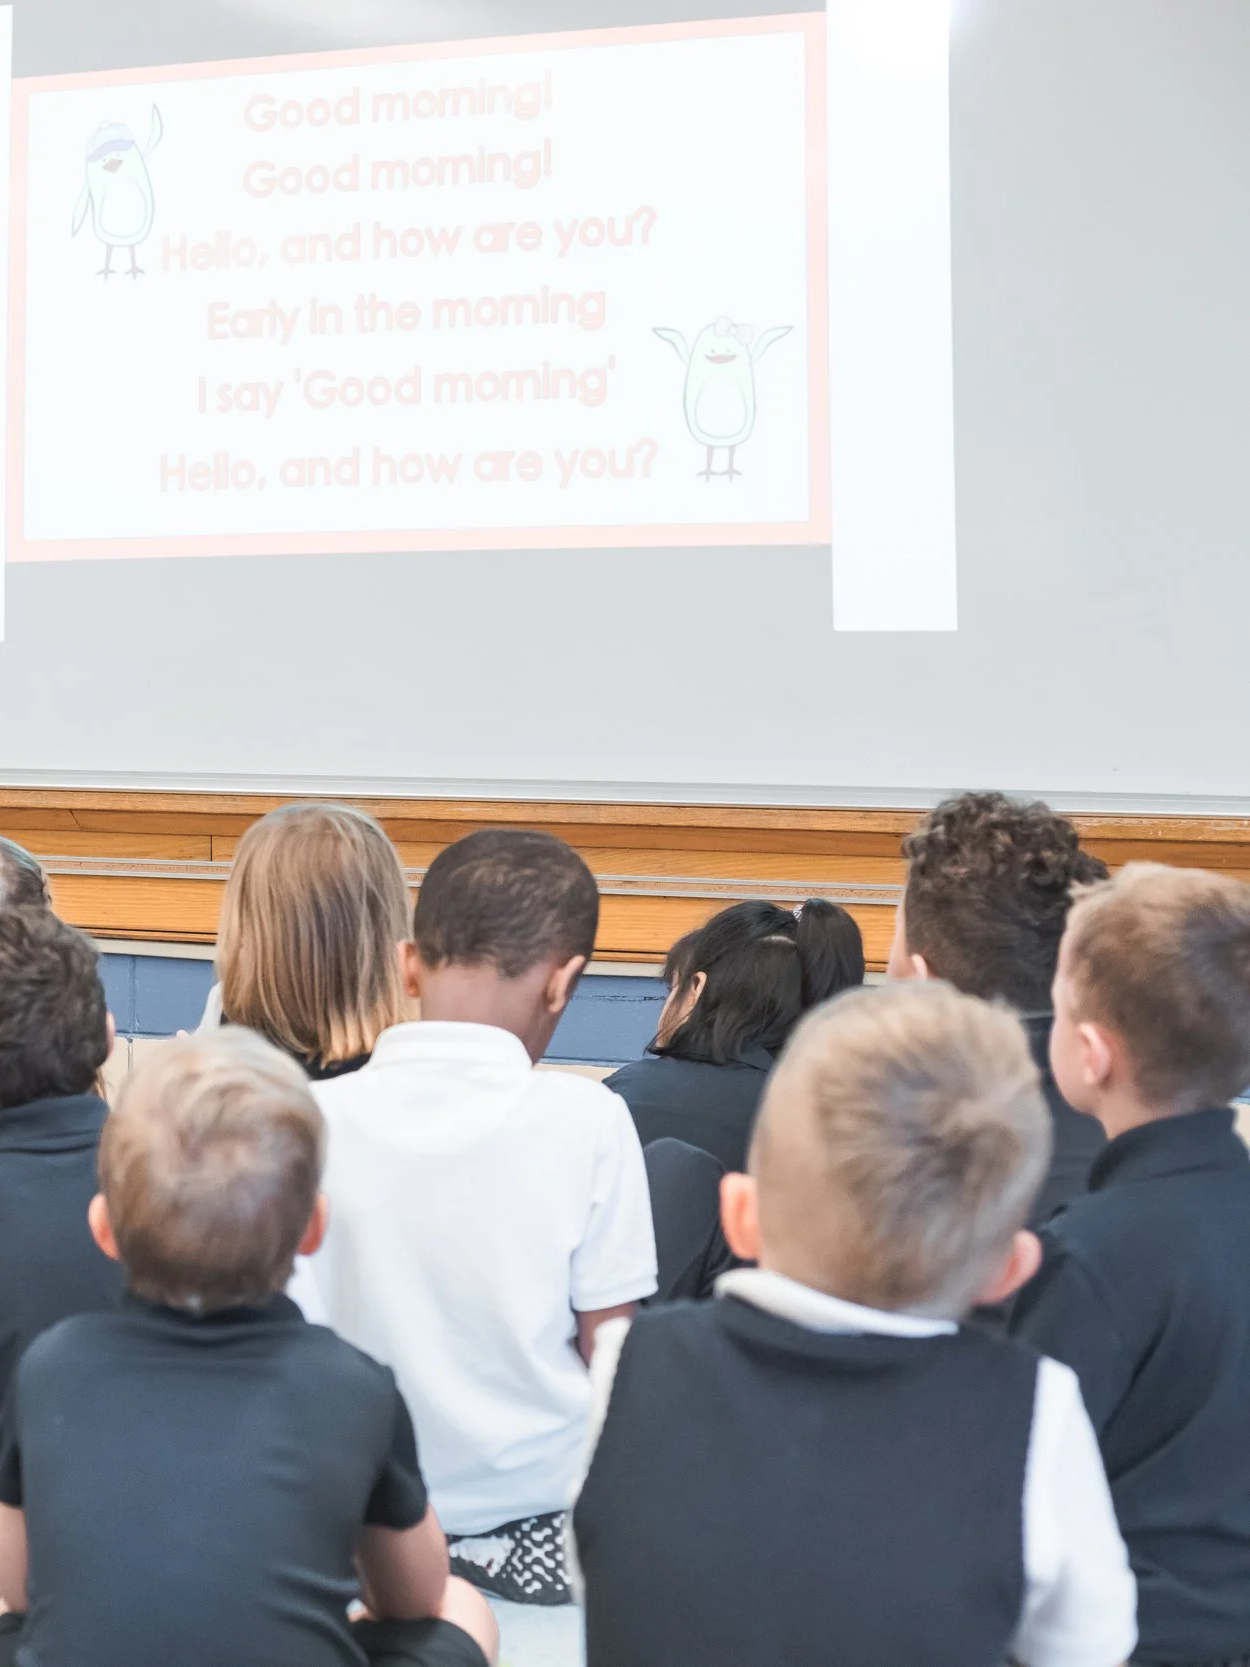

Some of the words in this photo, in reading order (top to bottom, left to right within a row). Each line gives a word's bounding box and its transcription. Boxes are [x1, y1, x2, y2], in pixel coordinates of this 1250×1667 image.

[243, 87, 360, 133] Good
[372, 69, 553, 123] morning!
[242, 153, 360, 199] Good
[370, 138, 552, 190] morning!
[161, 230, 269, 272] Hello,
[280, 223, 361, 265] and
[372, 221, 463, 259] how
[473, 219, 542, 252] are
[553, 205, 657, 258] you?
[207, 298, 301, 345] Early
[309, 297, 343, 334] in
[354, 292, 421, 332] the
[432, 284, 606, 330] morning
[197, 376, 207, 414] I
[216, 379, 285, 420] say
[293, 364, 421, 410] 'Good
[433, 355, 616, 408] morning'
[159, 450, 268, 493] Hello,
[279, 446, 361, 487] and
[372, 446, 463, 484] how
[473, 448, 542, 482] are
[554, 436, 658, 490] you?
